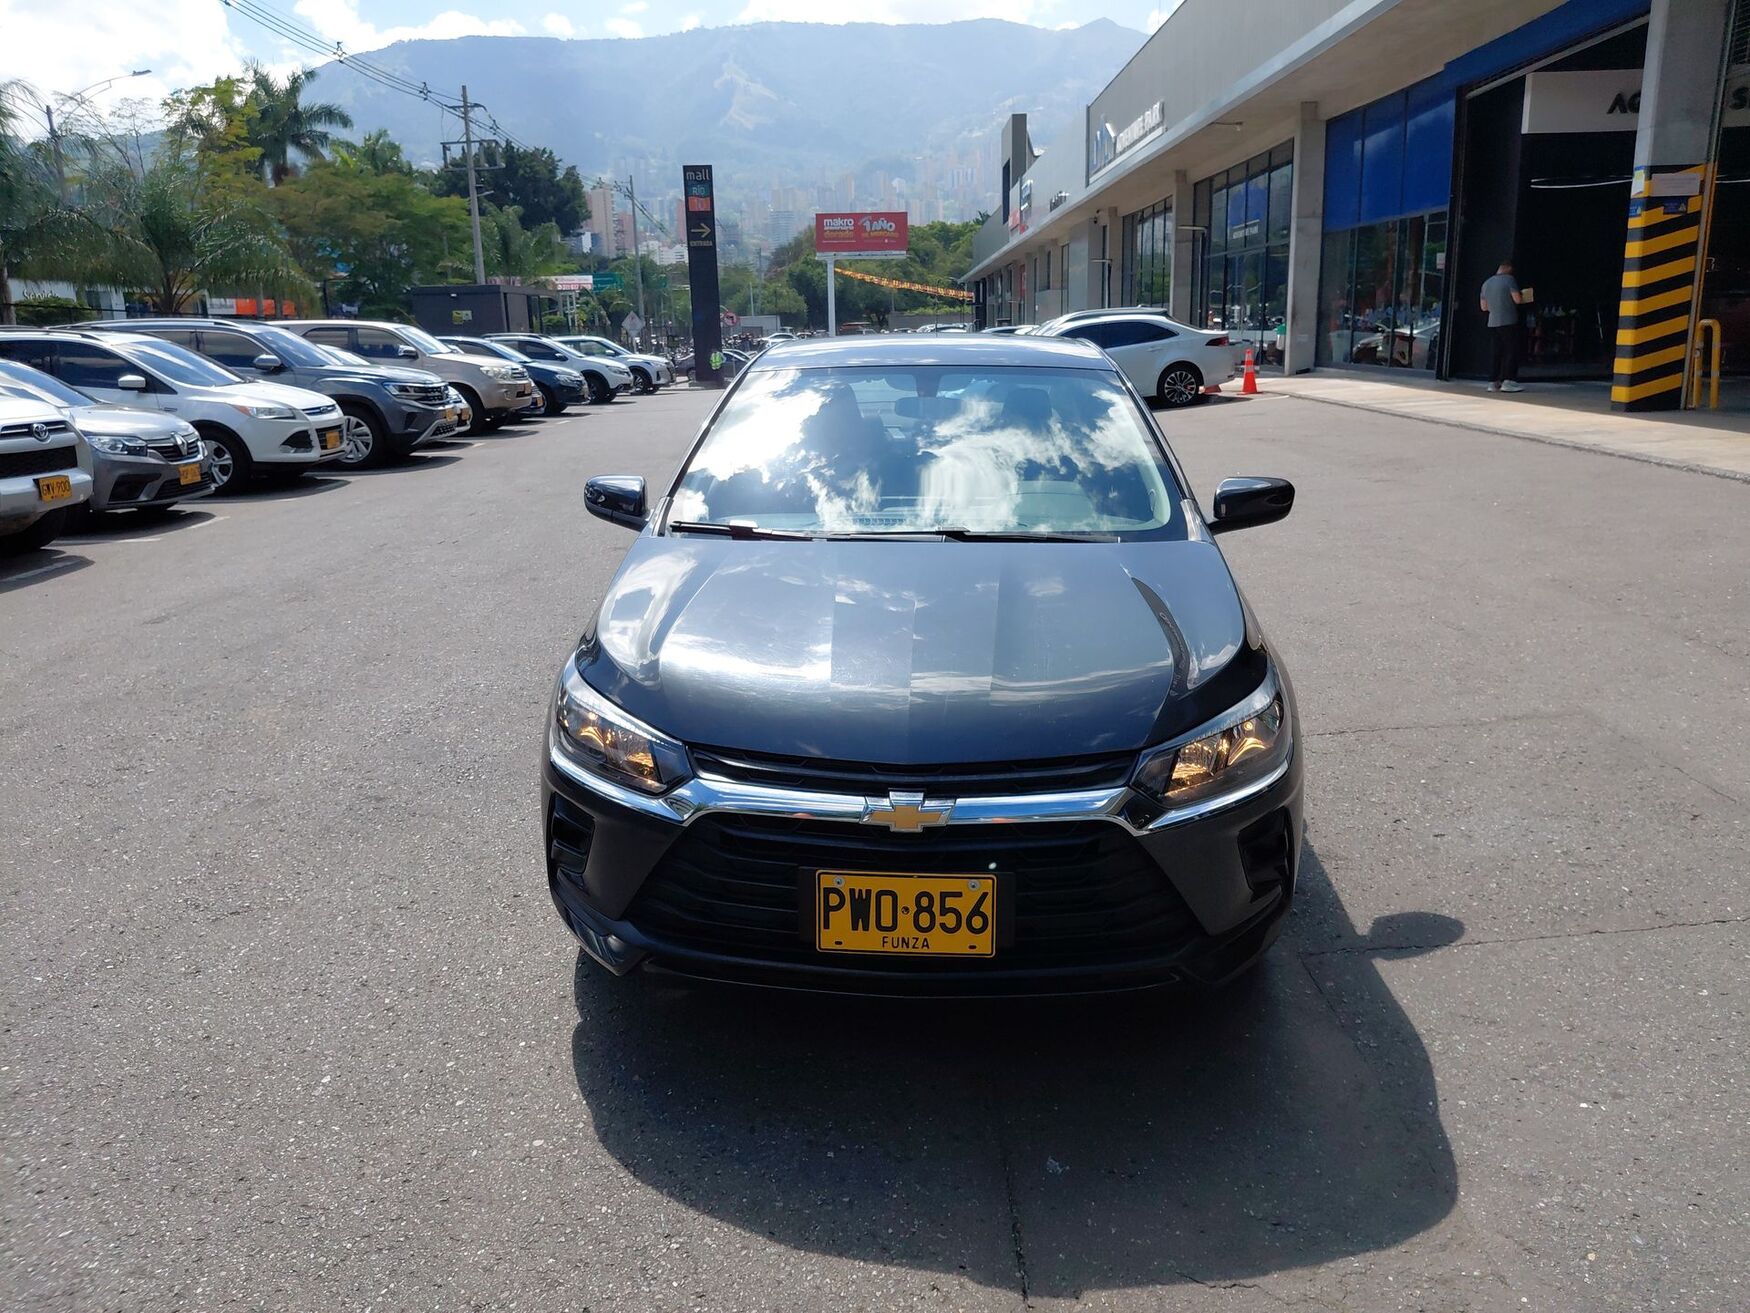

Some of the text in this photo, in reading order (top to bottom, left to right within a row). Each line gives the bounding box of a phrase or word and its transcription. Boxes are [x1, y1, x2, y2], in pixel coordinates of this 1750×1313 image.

[686, 169, 710, 181] mall
[823, 217, 855, 227] makro
[872, 218, 896, 232] AÑO
[881, 935, 931, 950] FUNZA
